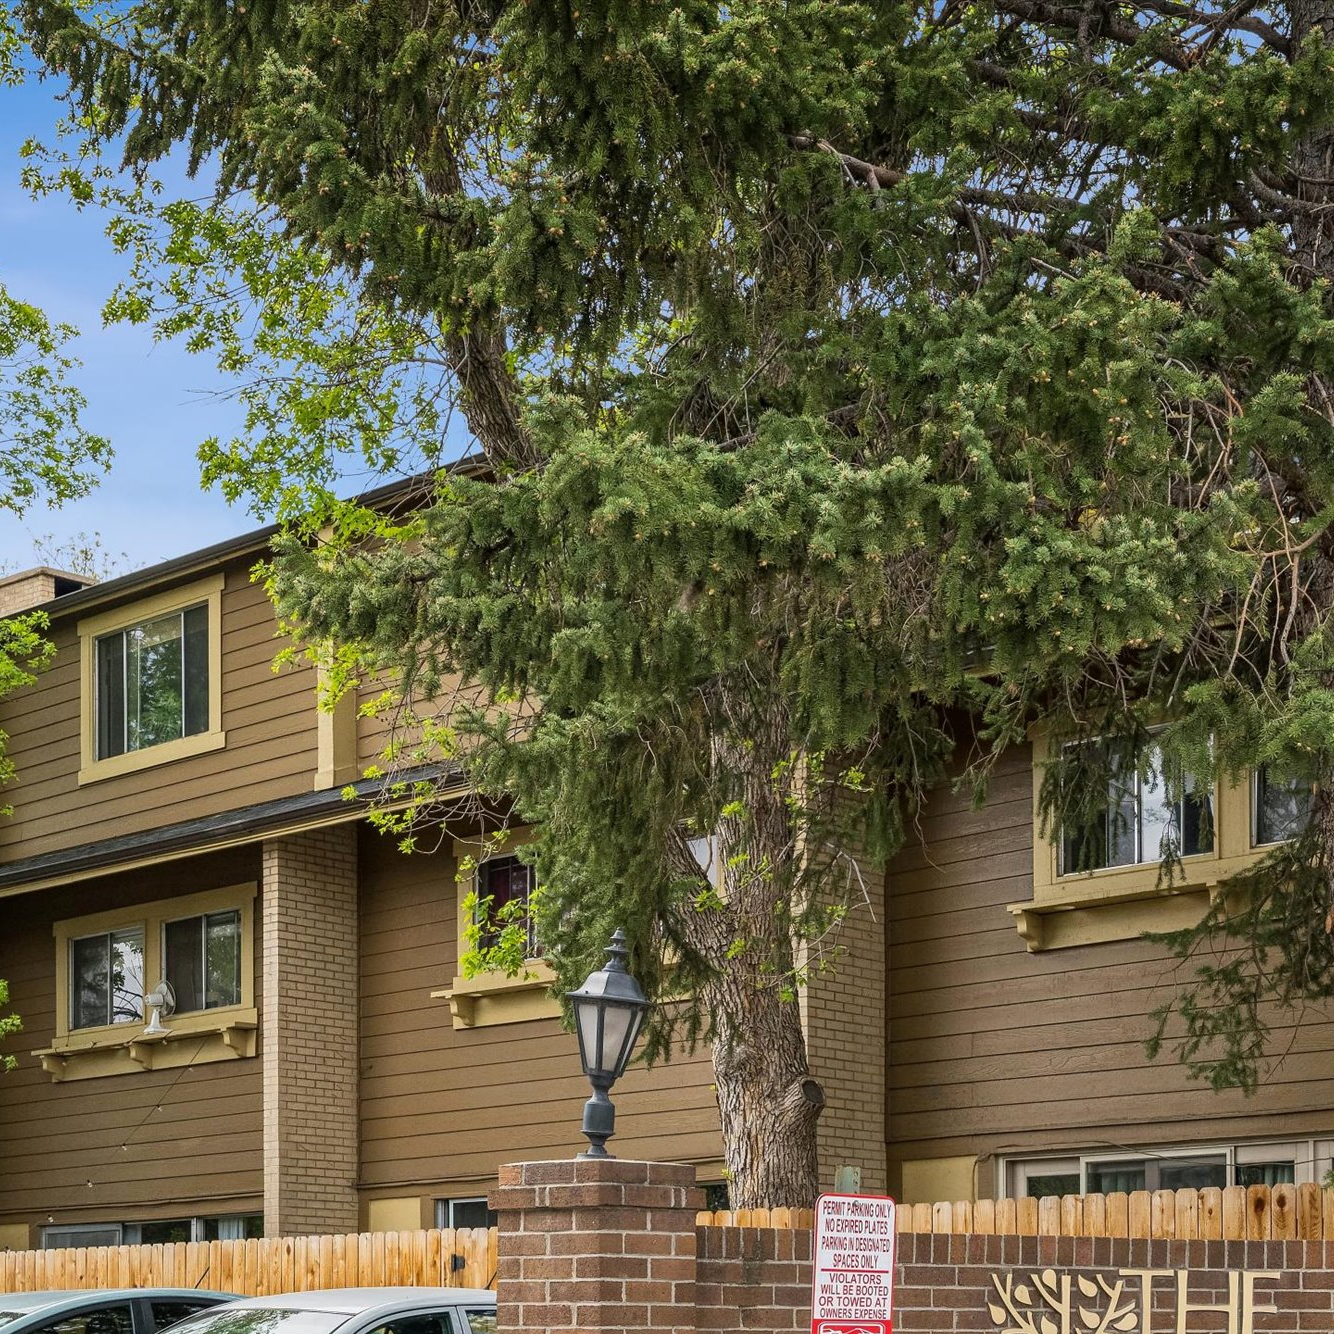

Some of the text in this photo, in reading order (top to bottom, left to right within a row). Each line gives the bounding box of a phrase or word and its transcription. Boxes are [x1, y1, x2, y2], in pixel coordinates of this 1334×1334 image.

[823, 1201, 891, 1218] PERMIT PARKING ONLY
[825, 1218, 888, 1235] NO EXPIRED PLATES
[822, 1236, 890, 1252] PARKING IN DESIGNATED
[833, 1254, 878, 1269] SPACES ONLY
[829, 1273, 882, 1284] VIOLATORS
[820, 1284, 889, 1296] WILL BE BOOTED
[819, 1296, 887, 1307] OR TOWED AT
[820, 1308, 887, 1319] OWNERS EXPENSE
